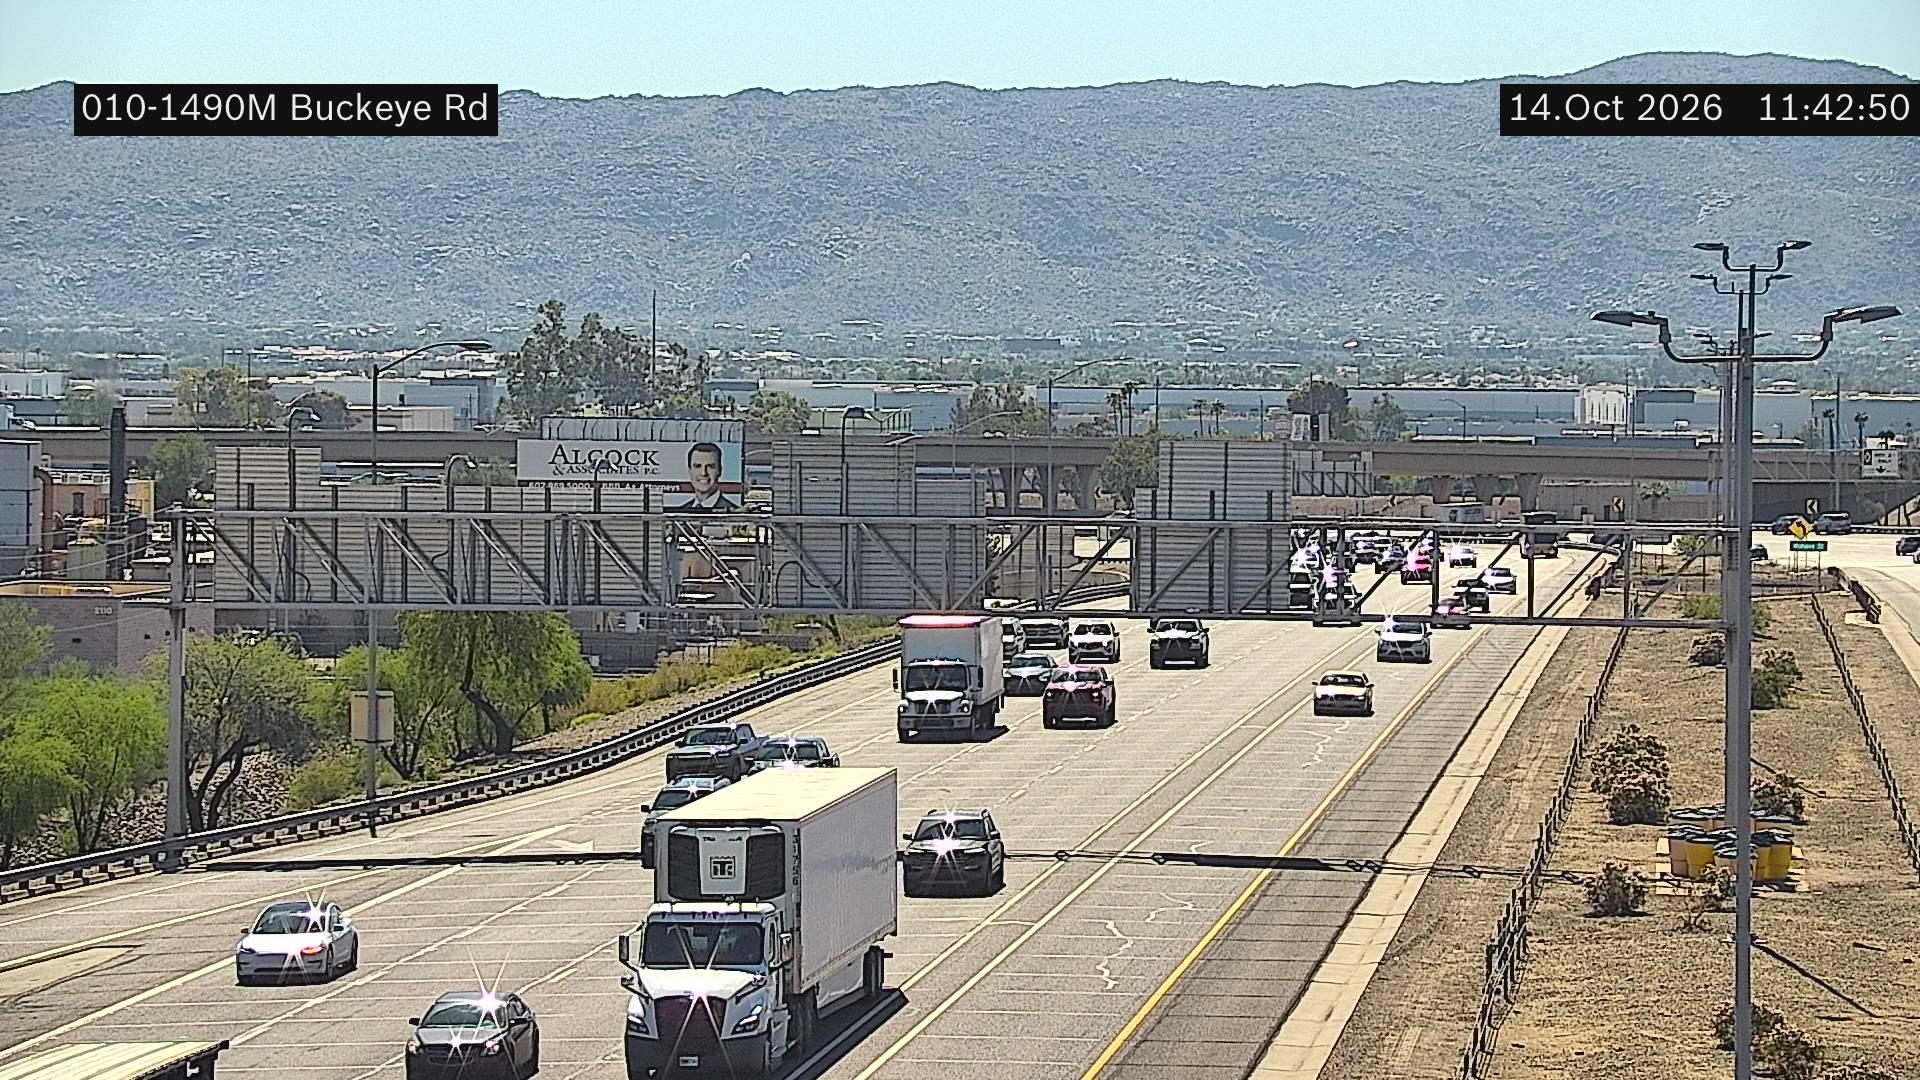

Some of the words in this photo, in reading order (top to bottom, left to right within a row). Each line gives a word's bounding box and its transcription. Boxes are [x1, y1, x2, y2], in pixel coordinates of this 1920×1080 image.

[548, 443, 660, 466] ALCOCK
[553, 464, 565, 476] &
[94, 606, 112, 614] 2110
